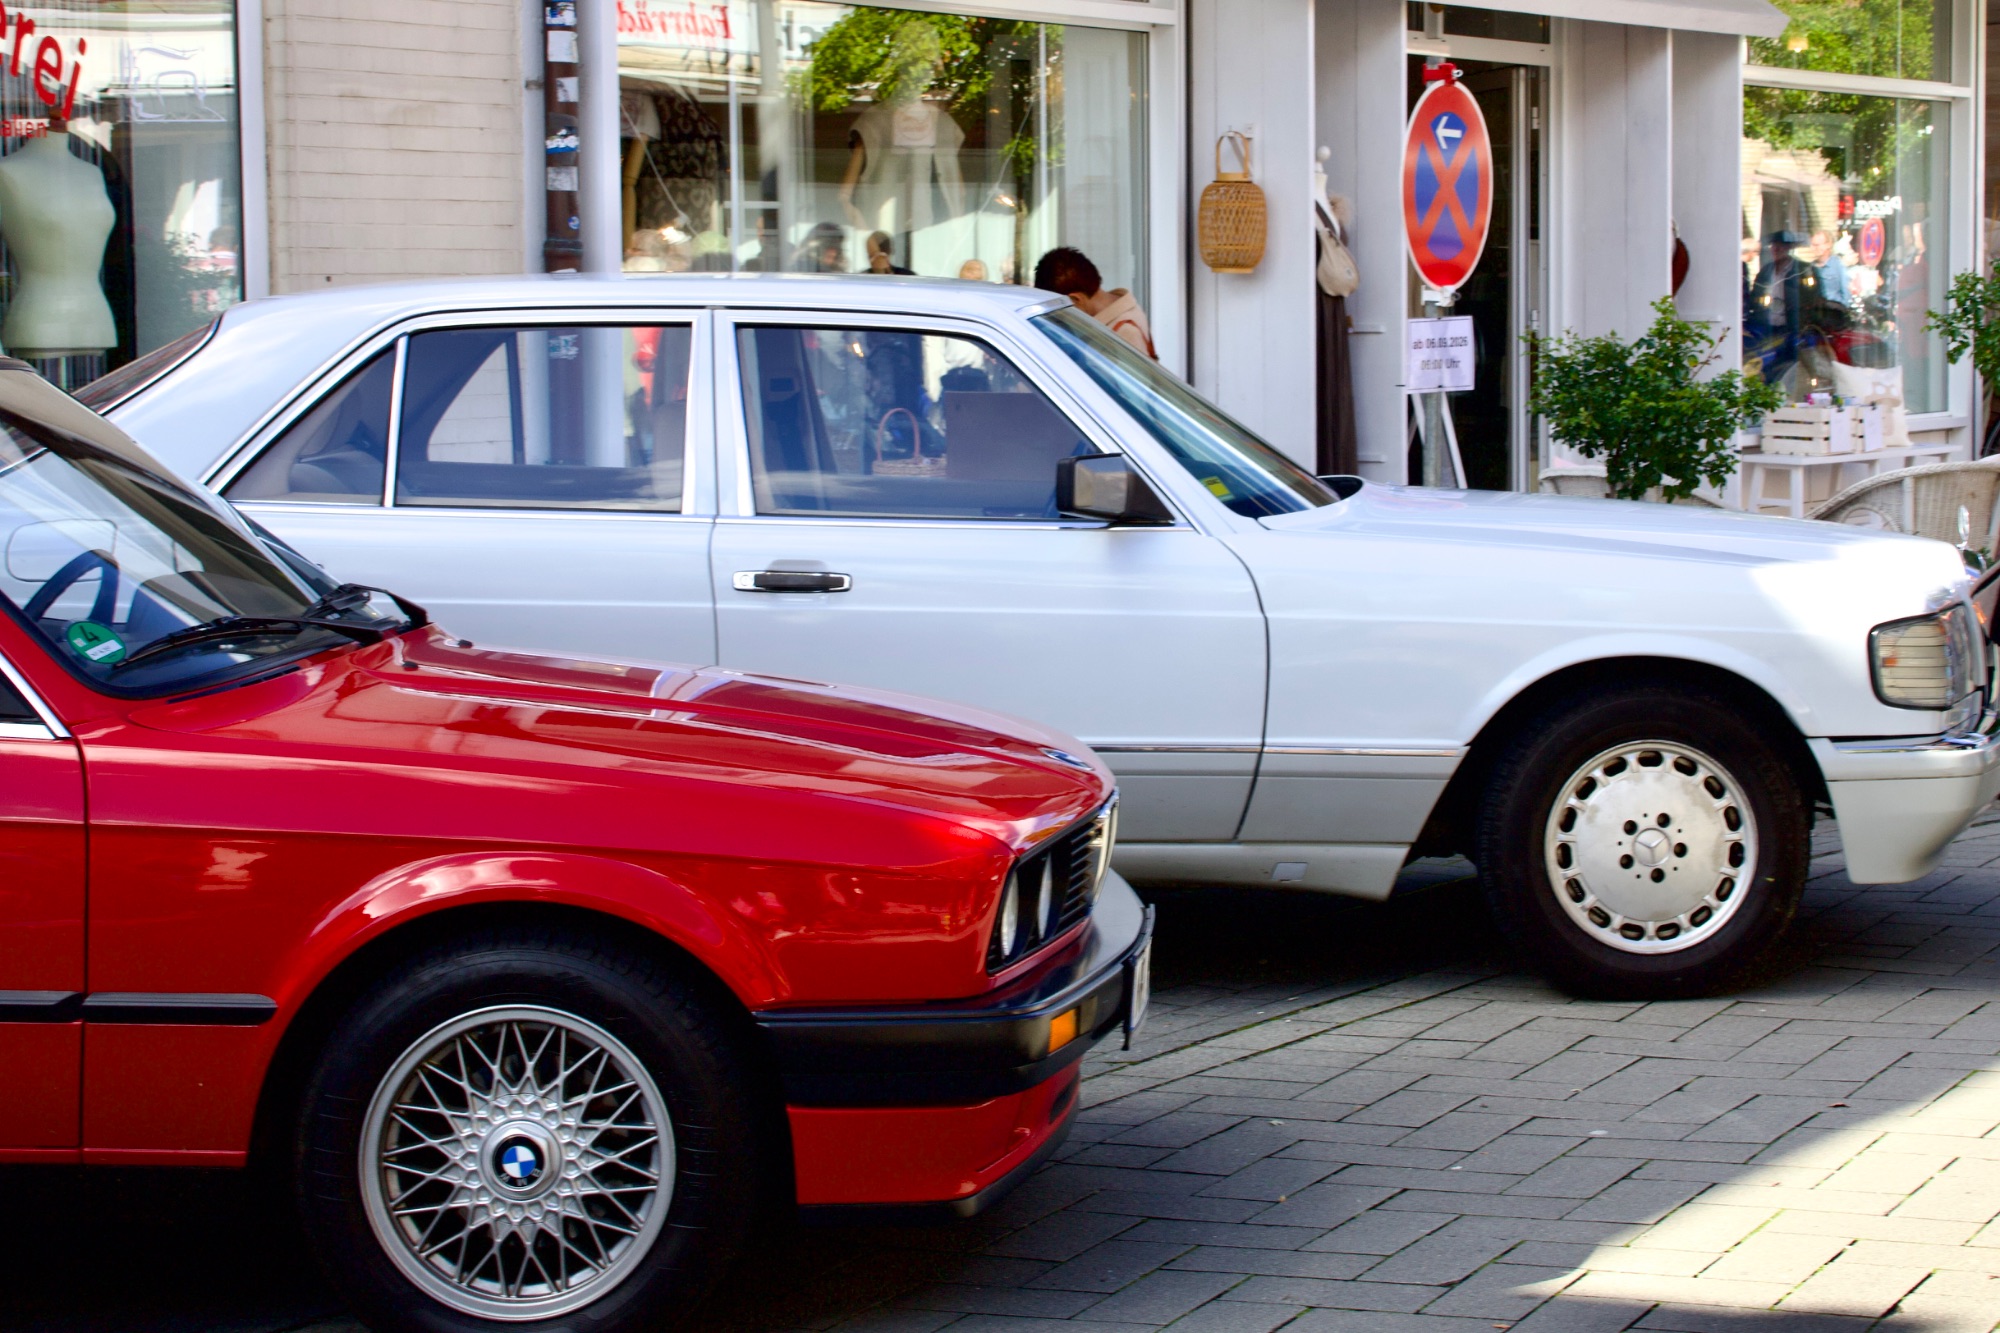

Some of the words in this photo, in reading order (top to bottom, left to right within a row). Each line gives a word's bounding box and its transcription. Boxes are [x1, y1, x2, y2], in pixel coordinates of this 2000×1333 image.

[0, 0, 87, 122] rei
[1445, 358, 1461, 369] Uhr
[79, 625, 101, 642] 4
